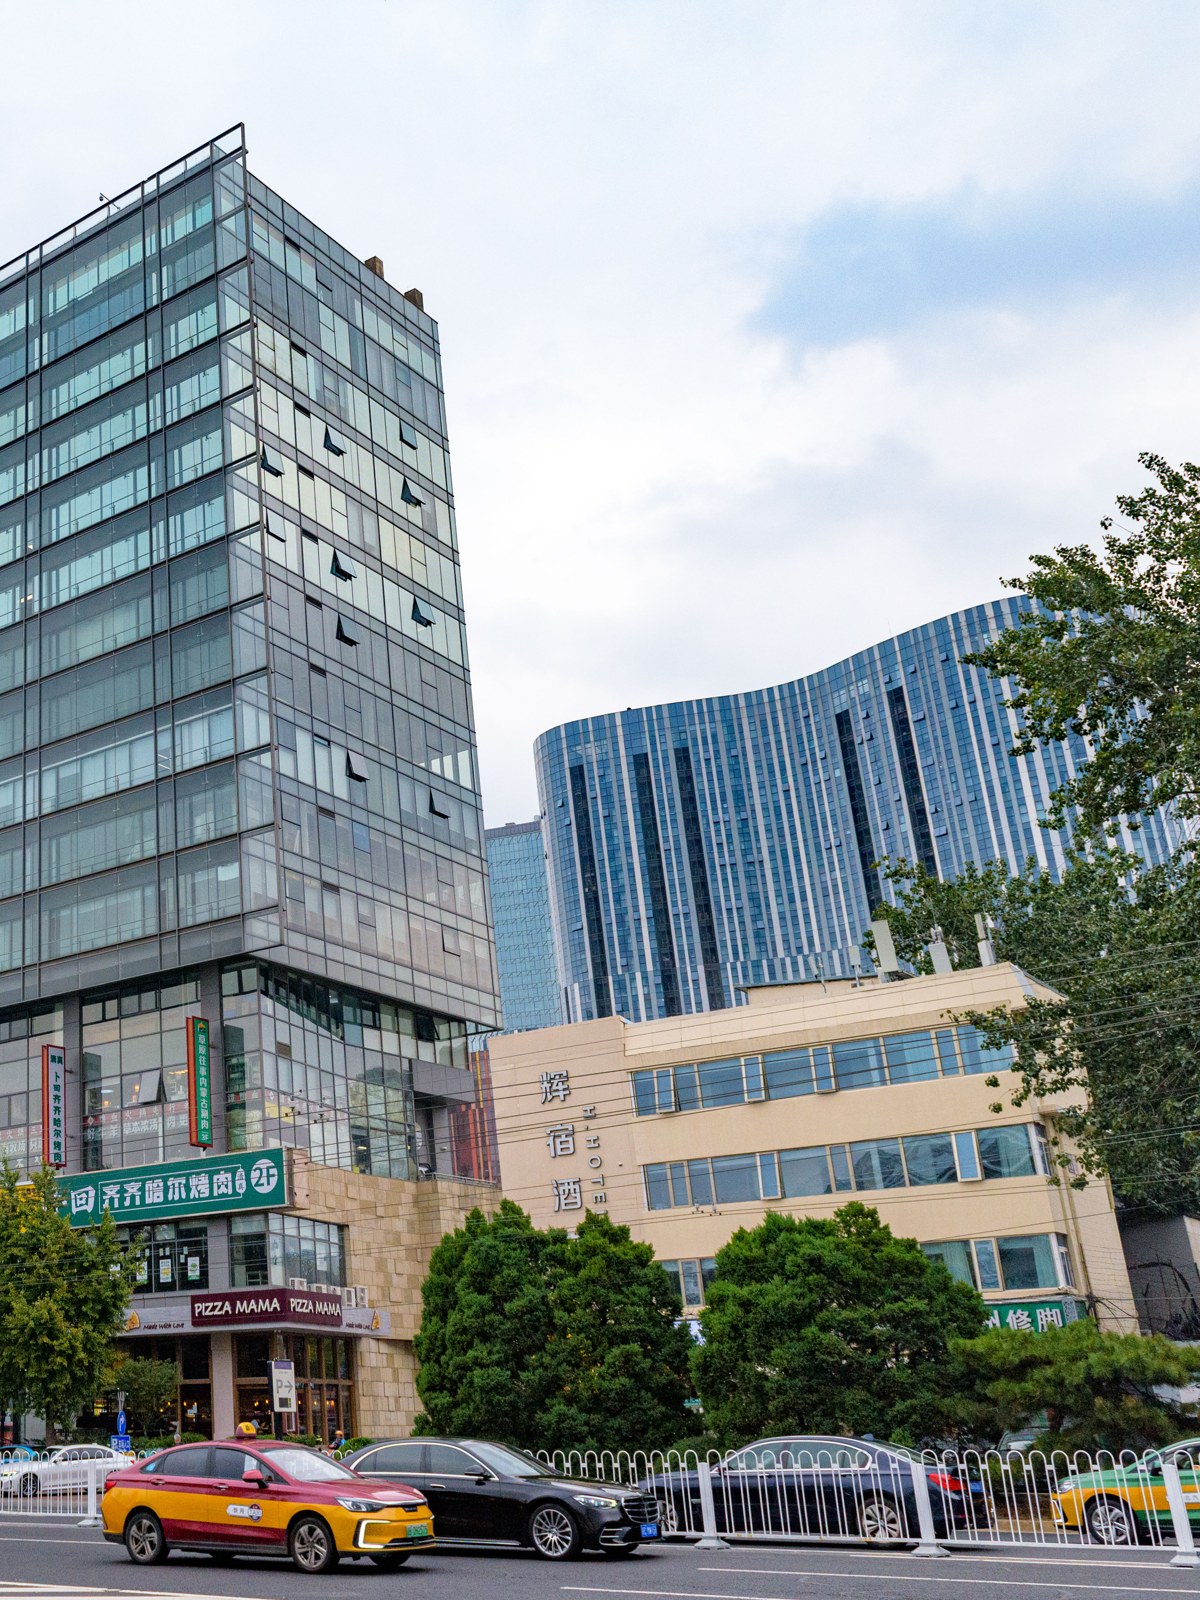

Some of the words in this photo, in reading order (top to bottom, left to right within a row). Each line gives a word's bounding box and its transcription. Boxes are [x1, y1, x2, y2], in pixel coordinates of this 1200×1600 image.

[540, 1070, 582, 1238] 辉宿酒
[253, 1166, 276, 1187] 2F
[102, 1170, 233, 1209] 齐齐哈尔烤肉
[194, 1301, 232, 1317] PIZZA
[235, 1298, 280, 1314] MAMA
[289, 1298, 314, 1314] PIZZA
[314, 1301, 341, 1317] MAMA
[276, 1379, 283, 1394] P
